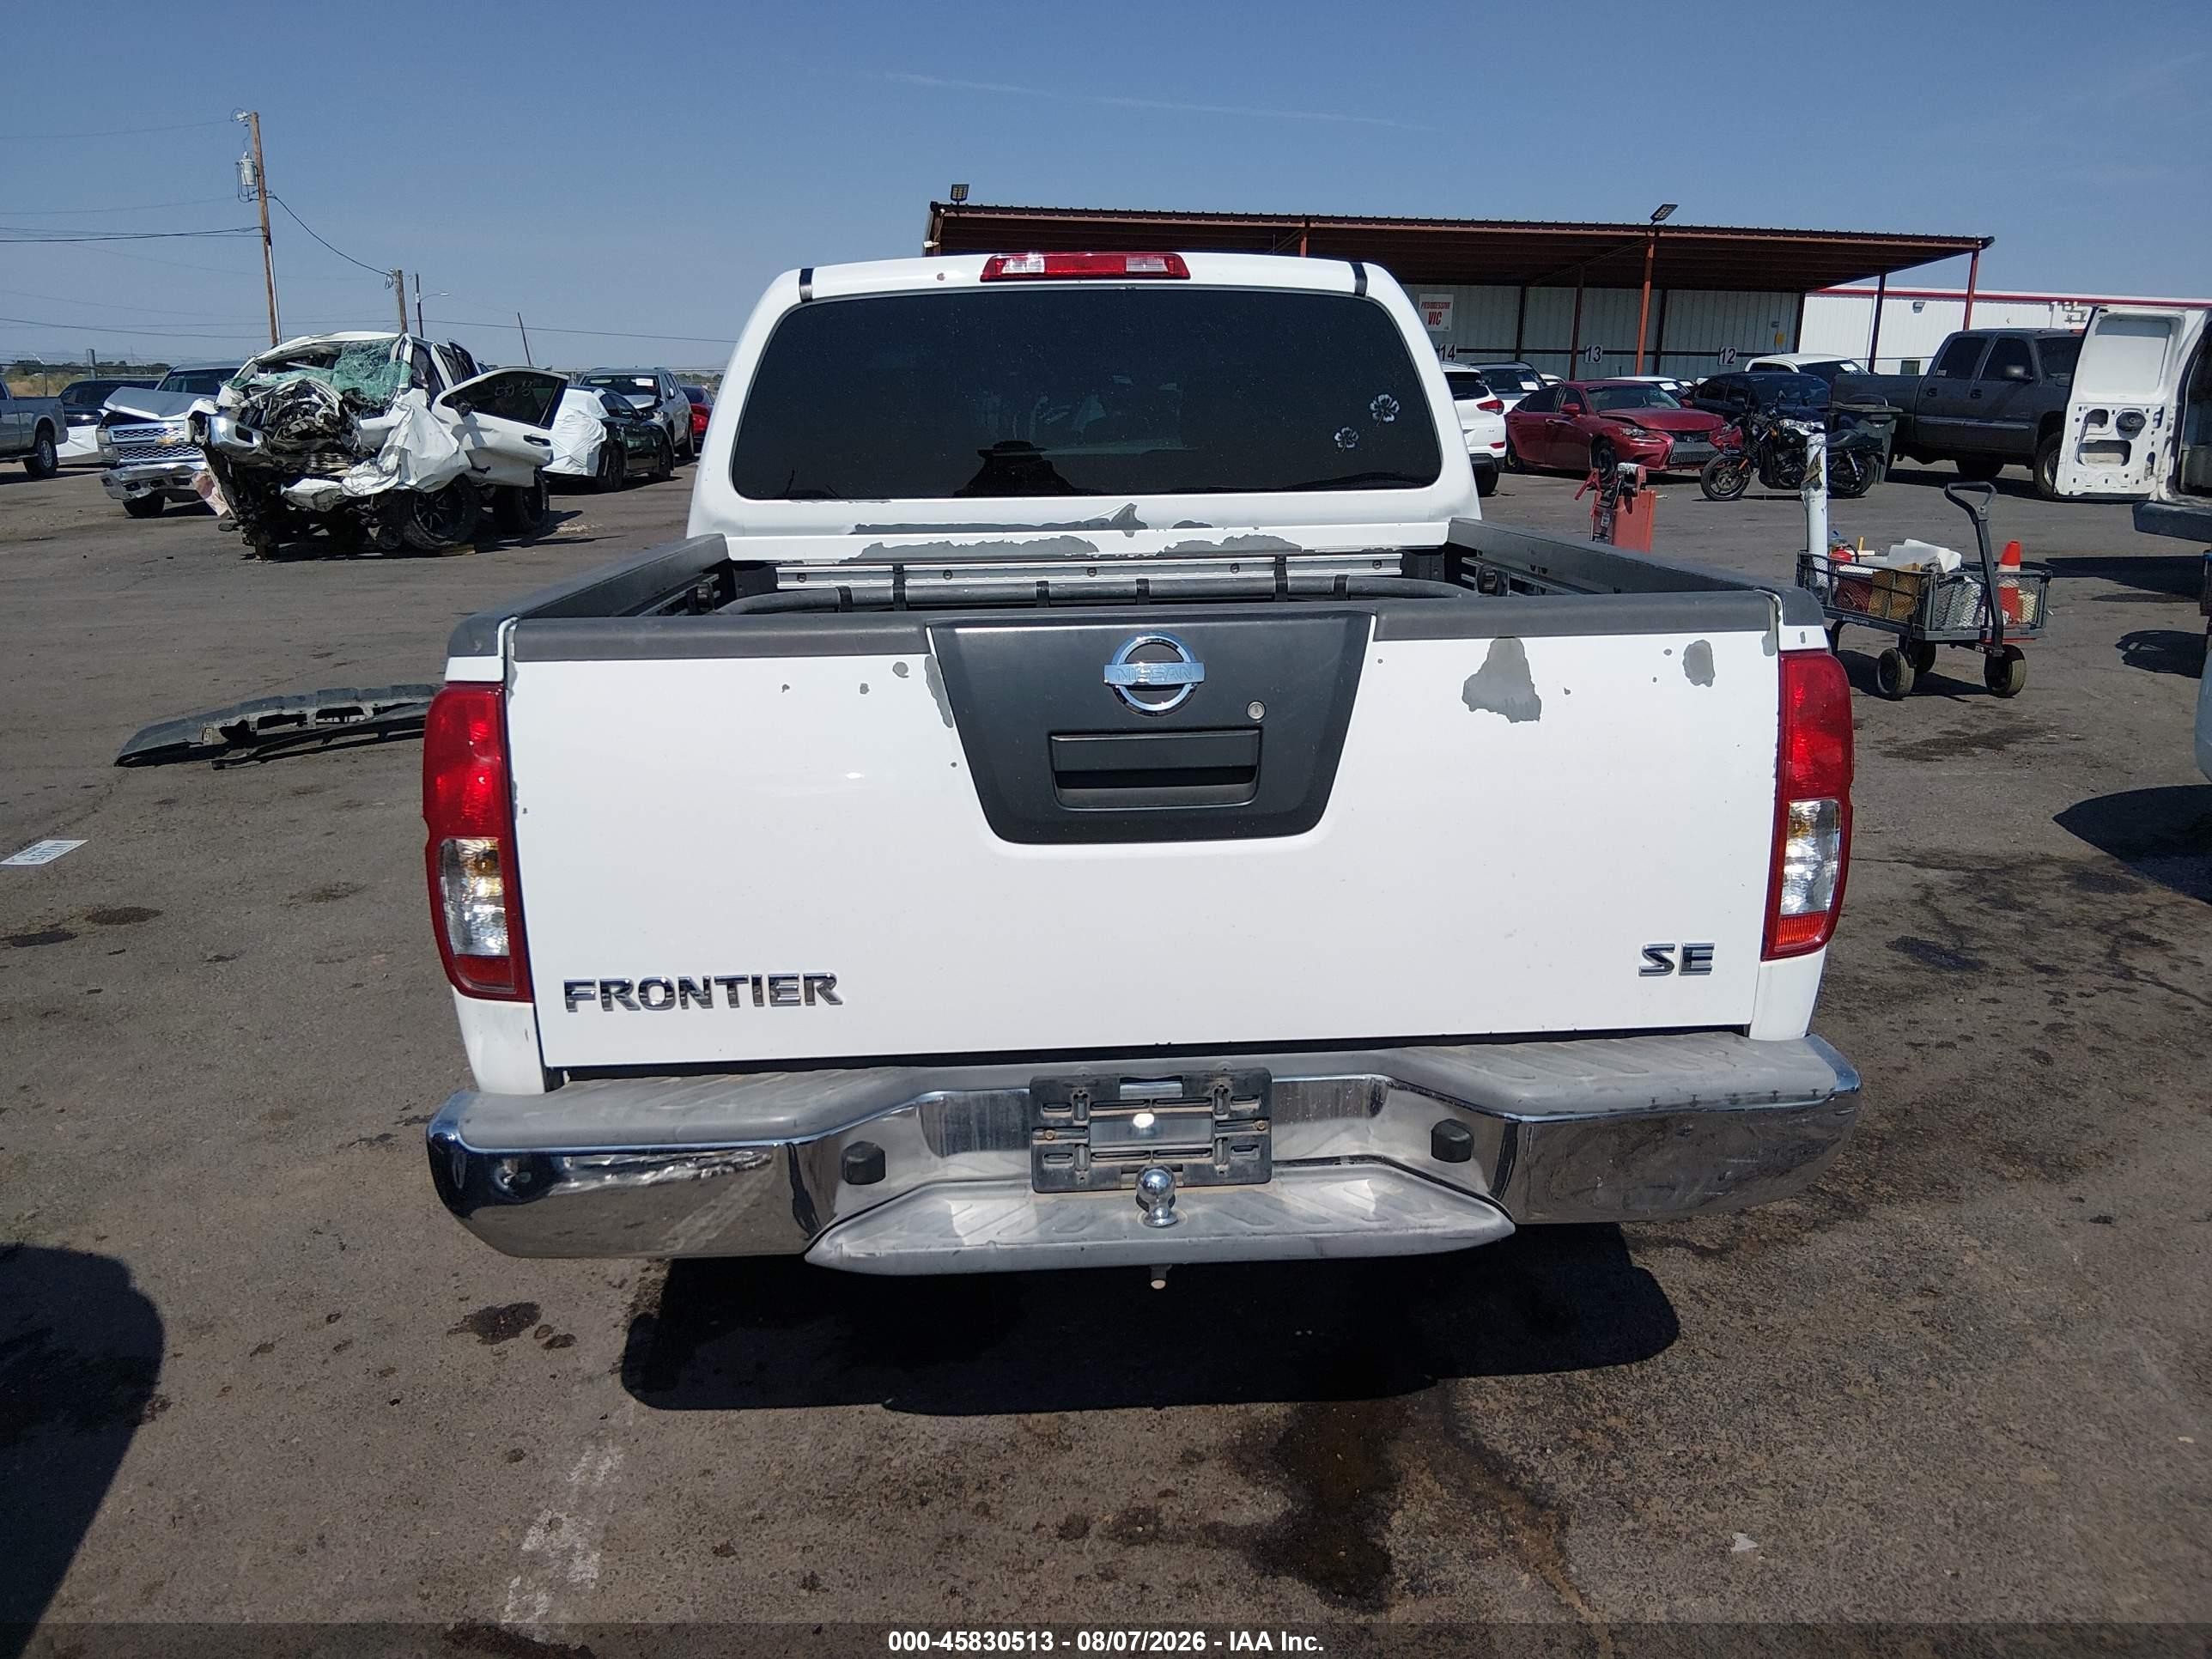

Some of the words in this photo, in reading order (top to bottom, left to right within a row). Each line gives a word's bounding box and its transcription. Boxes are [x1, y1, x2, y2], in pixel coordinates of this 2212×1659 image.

[1428, 311, 1443, 325] VIC
[1440, 343, 1455, 362] 14
[1585, 345, 1601, 362] 13
[1719, 347, 1736, 364] 12
[1115, 665, 1194, 683] NISSAN
[1638, 943, 1715, 977] SE
[563, 972, 843, 1012] FRONTIER
